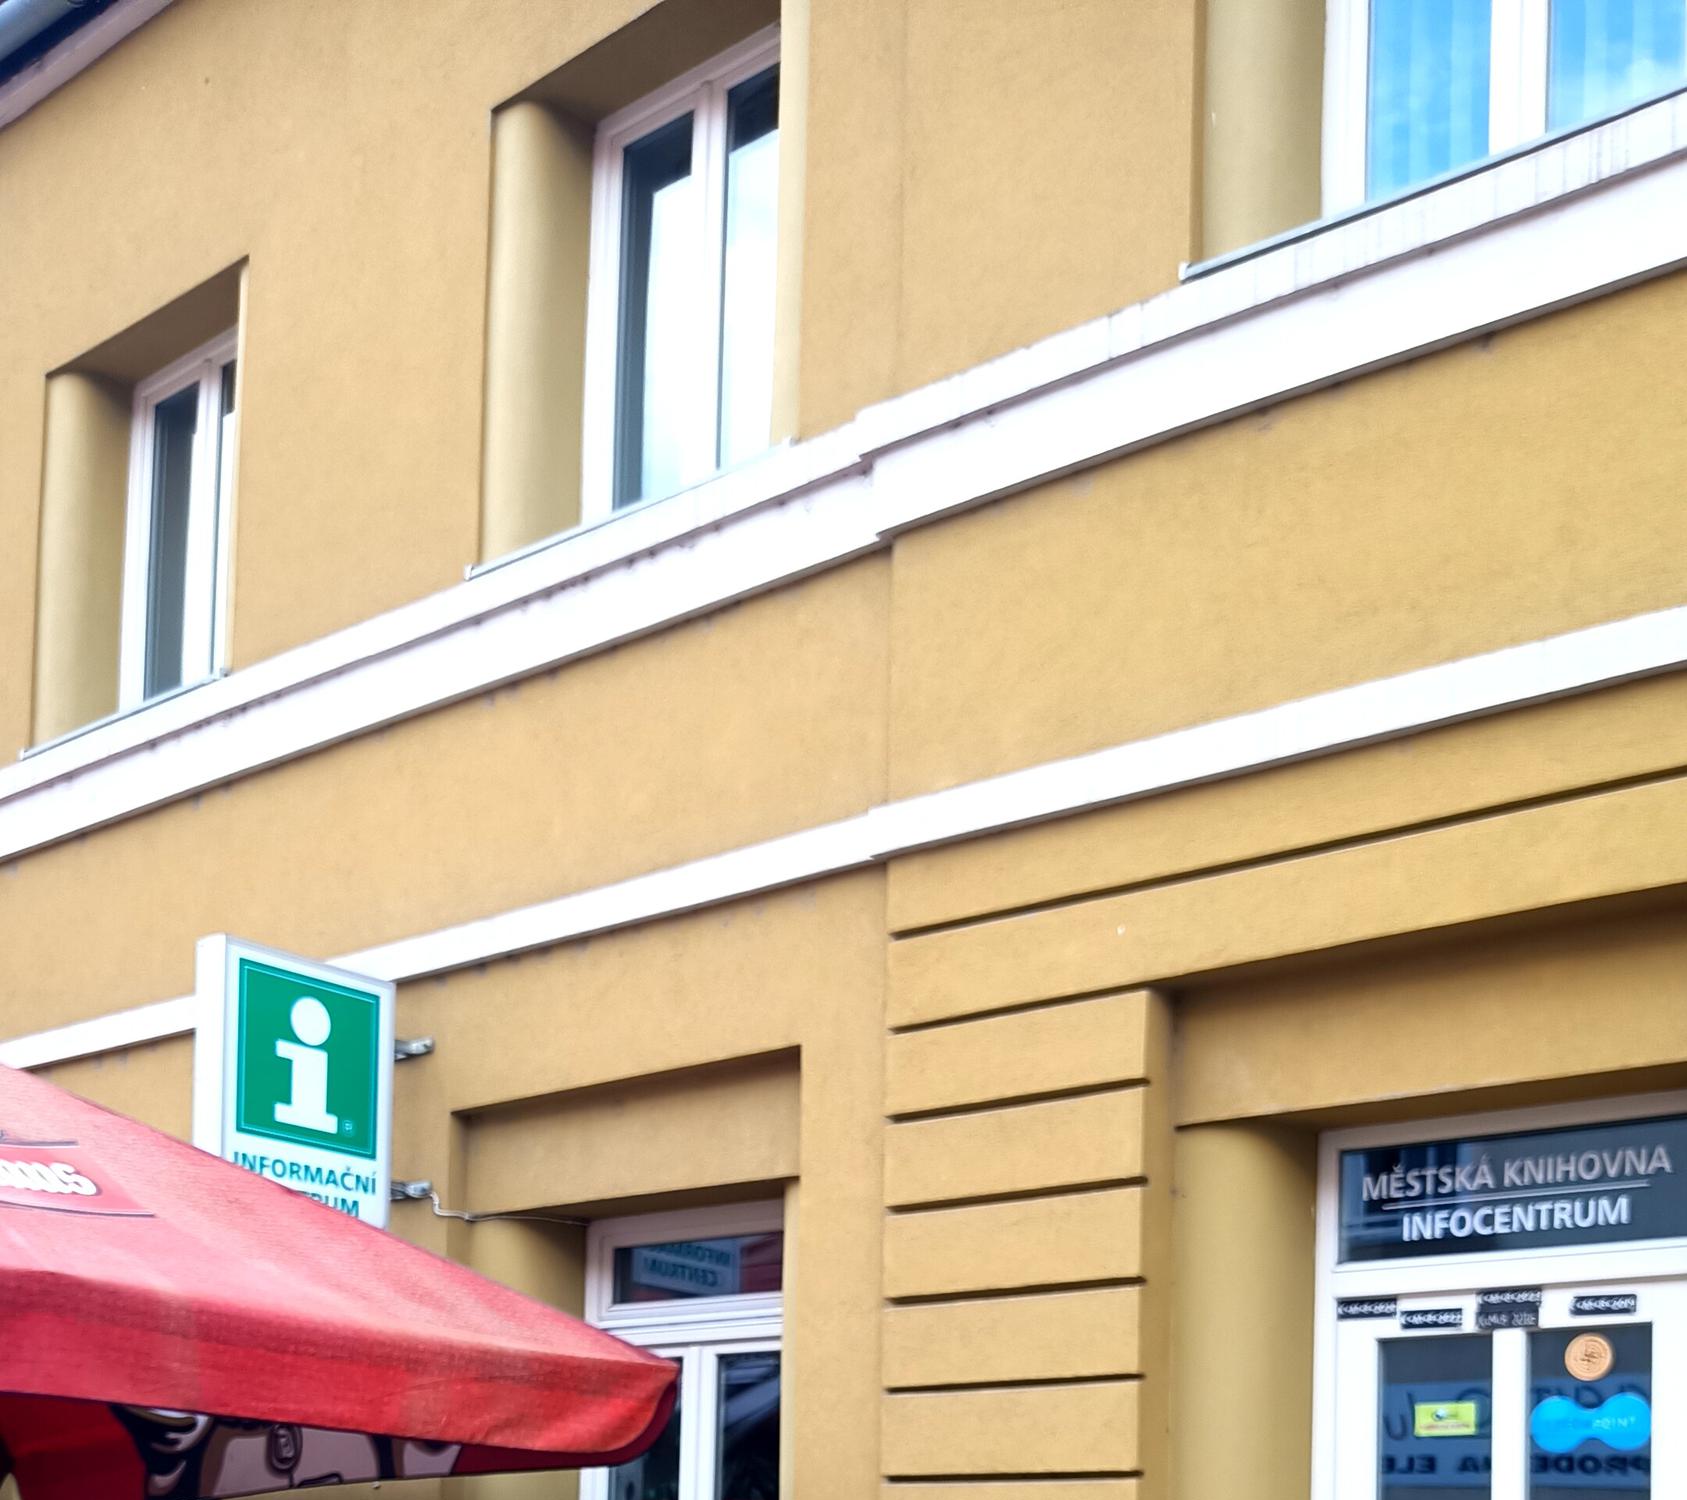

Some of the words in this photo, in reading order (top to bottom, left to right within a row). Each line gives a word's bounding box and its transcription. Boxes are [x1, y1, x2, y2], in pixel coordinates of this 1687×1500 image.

[234, 1152, 376, 1195] INFORMAČNÍ
[1362, 1156, 1497, 1201] MĚSTSKÁ
[1503, 1144, 1672, 1188] KNIHOVNA
[1402, 1194, 1632, 1242] INFOCENTRUM
